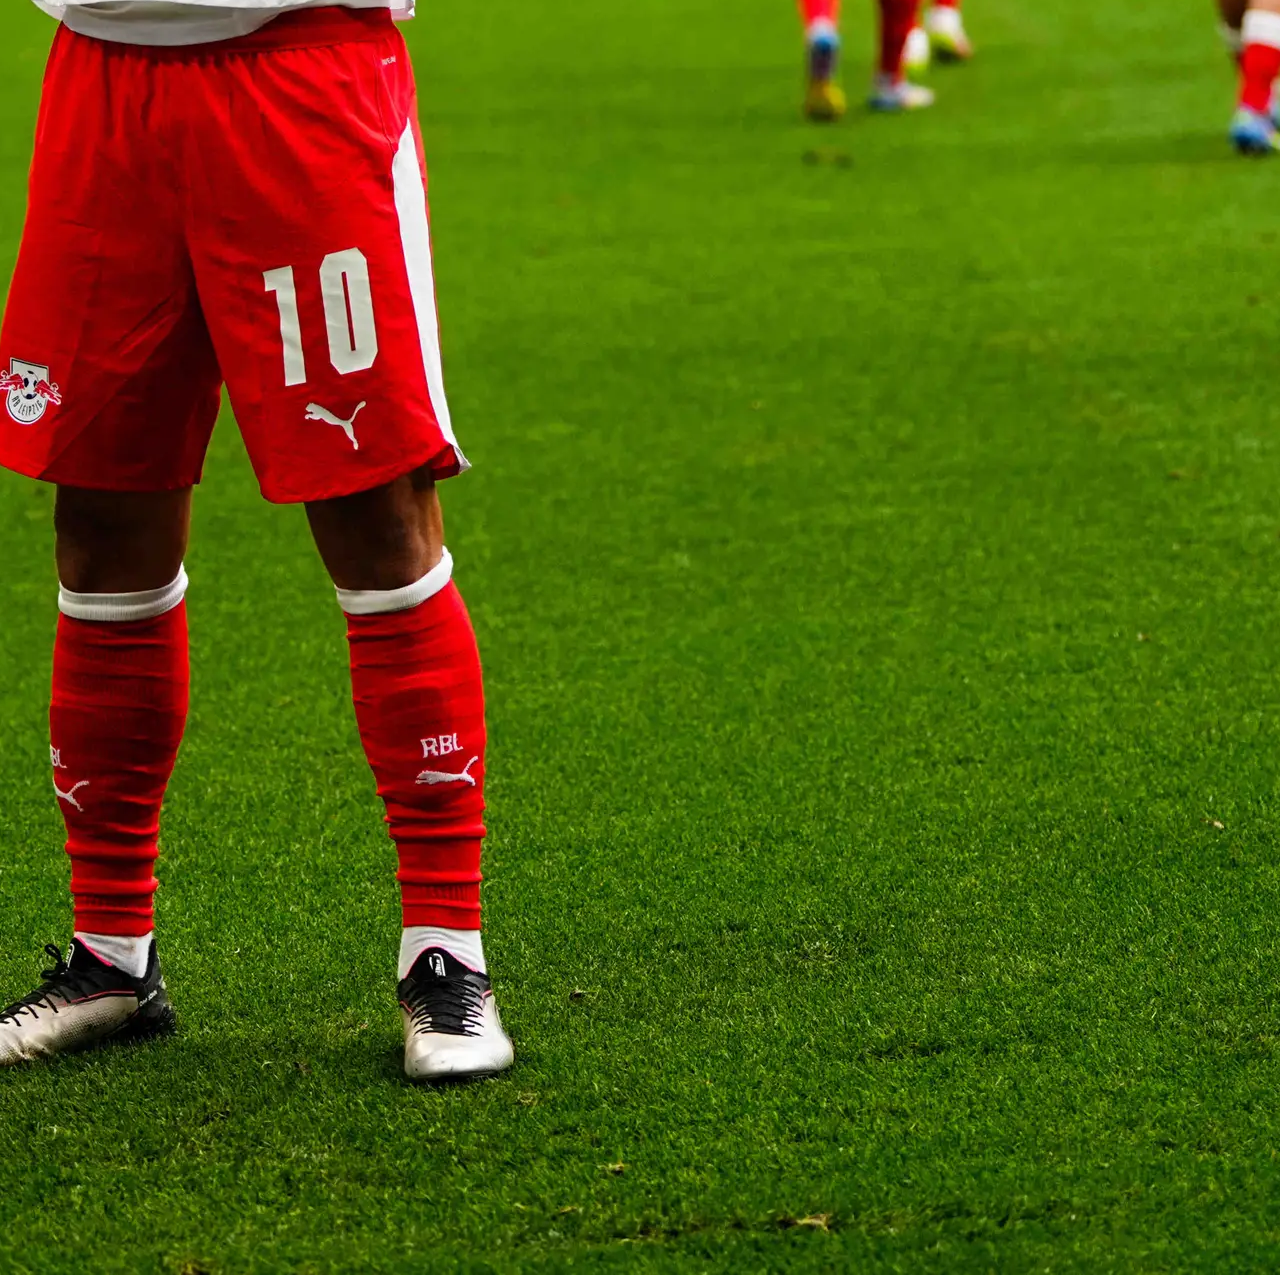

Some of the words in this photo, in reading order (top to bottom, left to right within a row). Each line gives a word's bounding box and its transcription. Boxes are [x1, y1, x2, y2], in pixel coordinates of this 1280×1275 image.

[262, 246, 379, 387] 10
[17, 400, 44, 416] LEIPZIG
[420, 732, 464, 759] RBL
